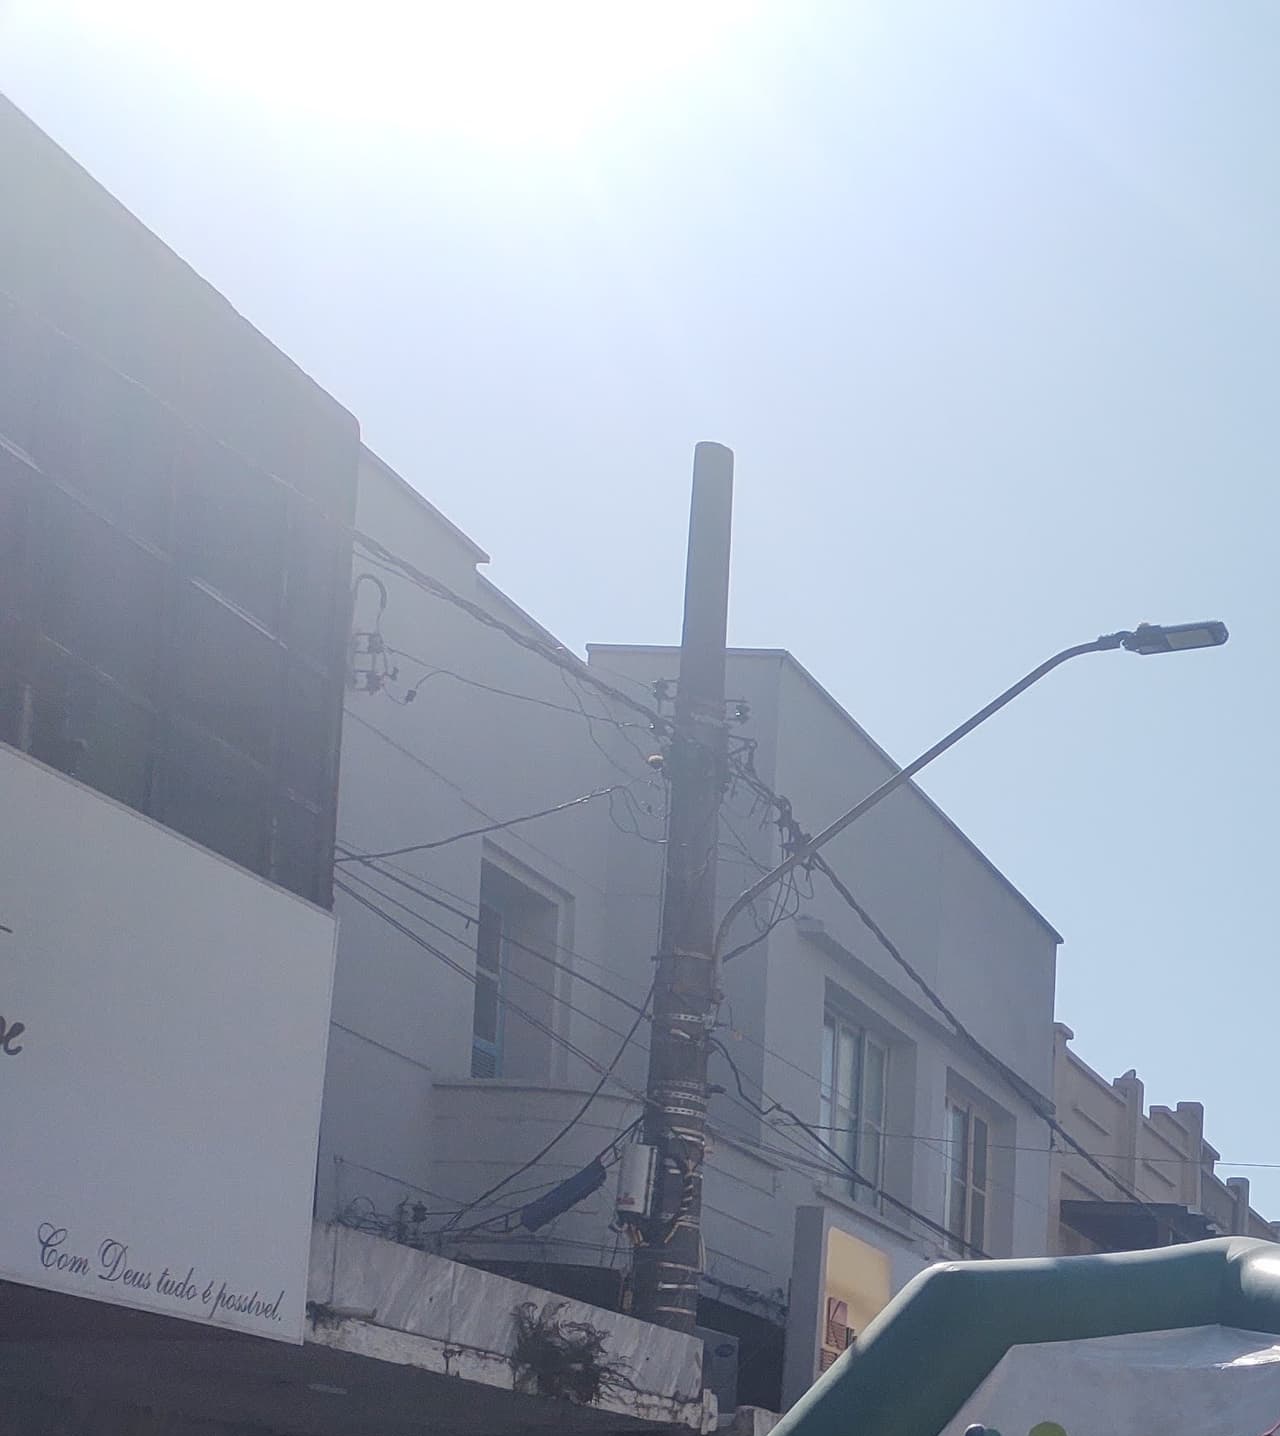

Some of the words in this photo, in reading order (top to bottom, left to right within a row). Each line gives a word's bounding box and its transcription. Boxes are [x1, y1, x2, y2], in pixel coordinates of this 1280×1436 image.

[38, 1222, 90, 1276] Com
[98, 1238, 152, 1290] Deus
[156, 1267, 197, 1301] tudo
[202, 1281, 215, 1305] é
